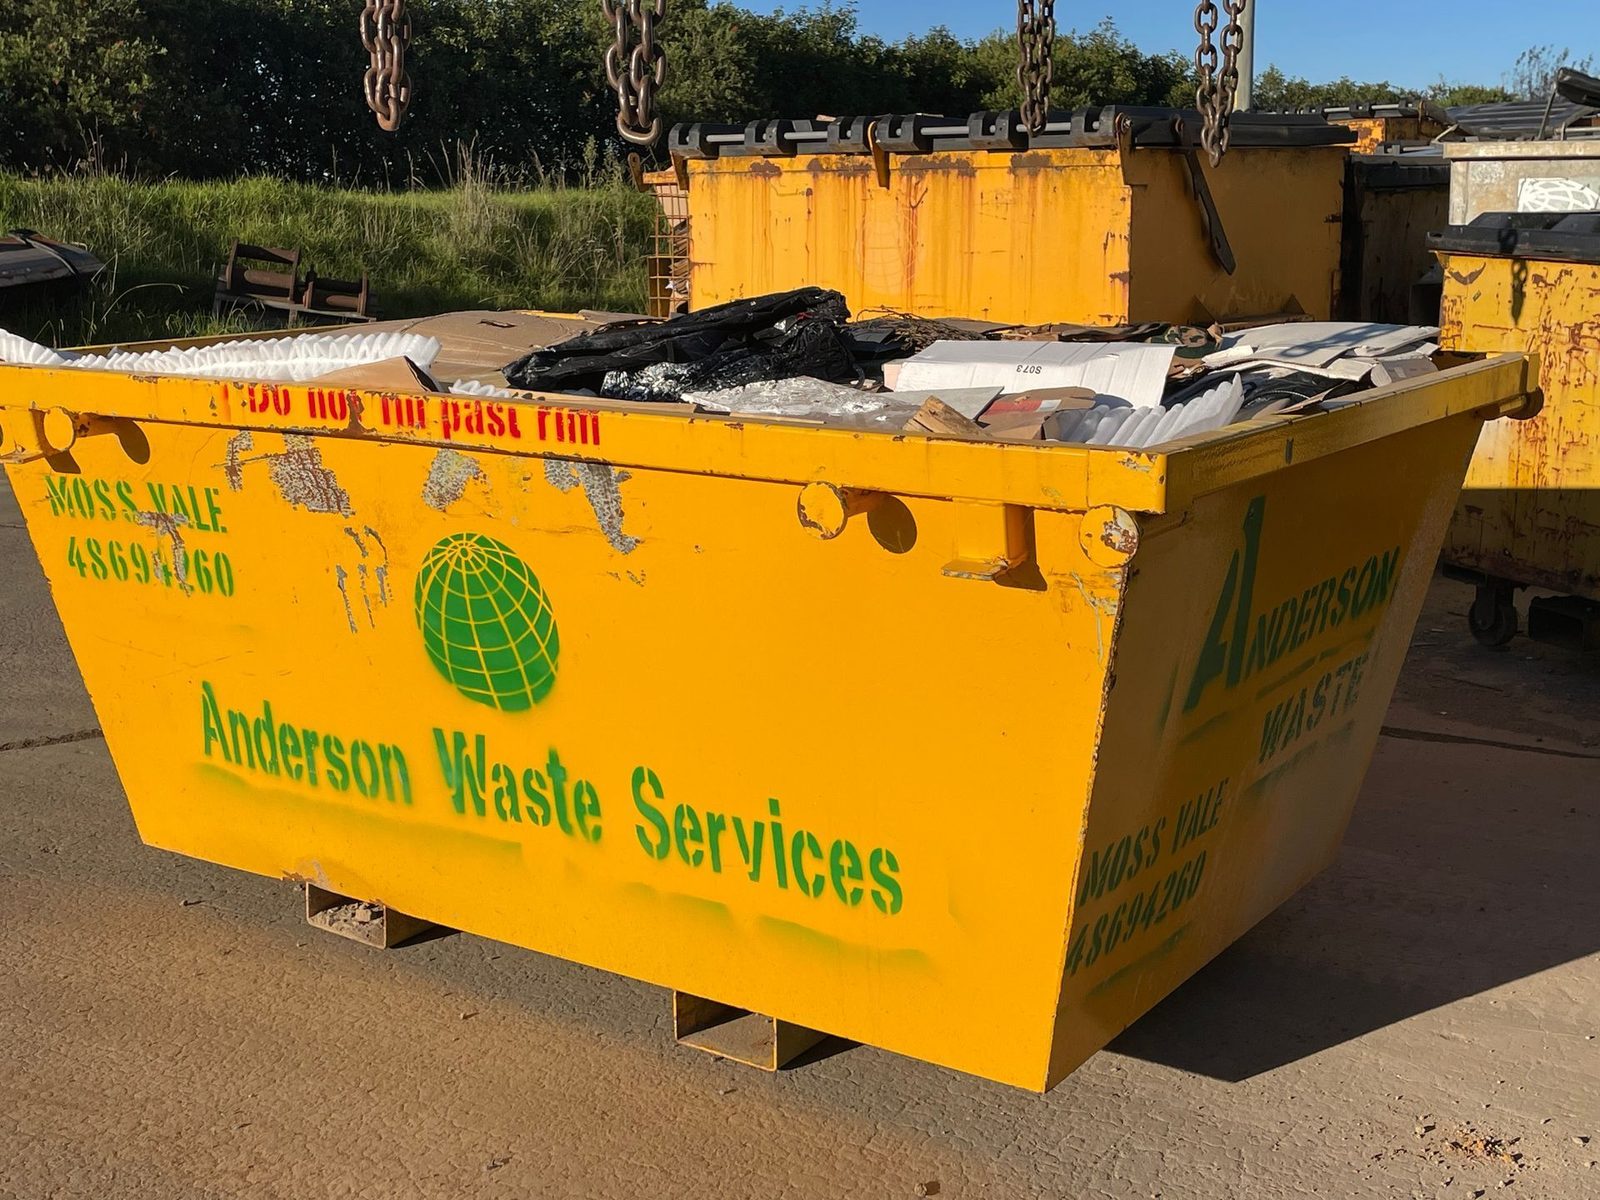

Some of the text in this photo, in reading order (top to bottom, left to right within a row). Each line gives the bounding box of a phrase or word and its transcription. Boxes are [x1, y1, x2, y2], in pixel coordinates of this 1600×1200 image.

[248, 383, 291, 416] Do
[440, 400, 521, 440] past
[1016, 364, 1042, 374] S073
[45, 475, 227, 533] MOSS VALE
[1258, 652, 1369, 766] WASTE
[200, 680, 904, 916] Anderson Waste Services
[1079, 776, 1230, 908] MOSS VALE
[1065, 850, 1207, 977] 48694260
